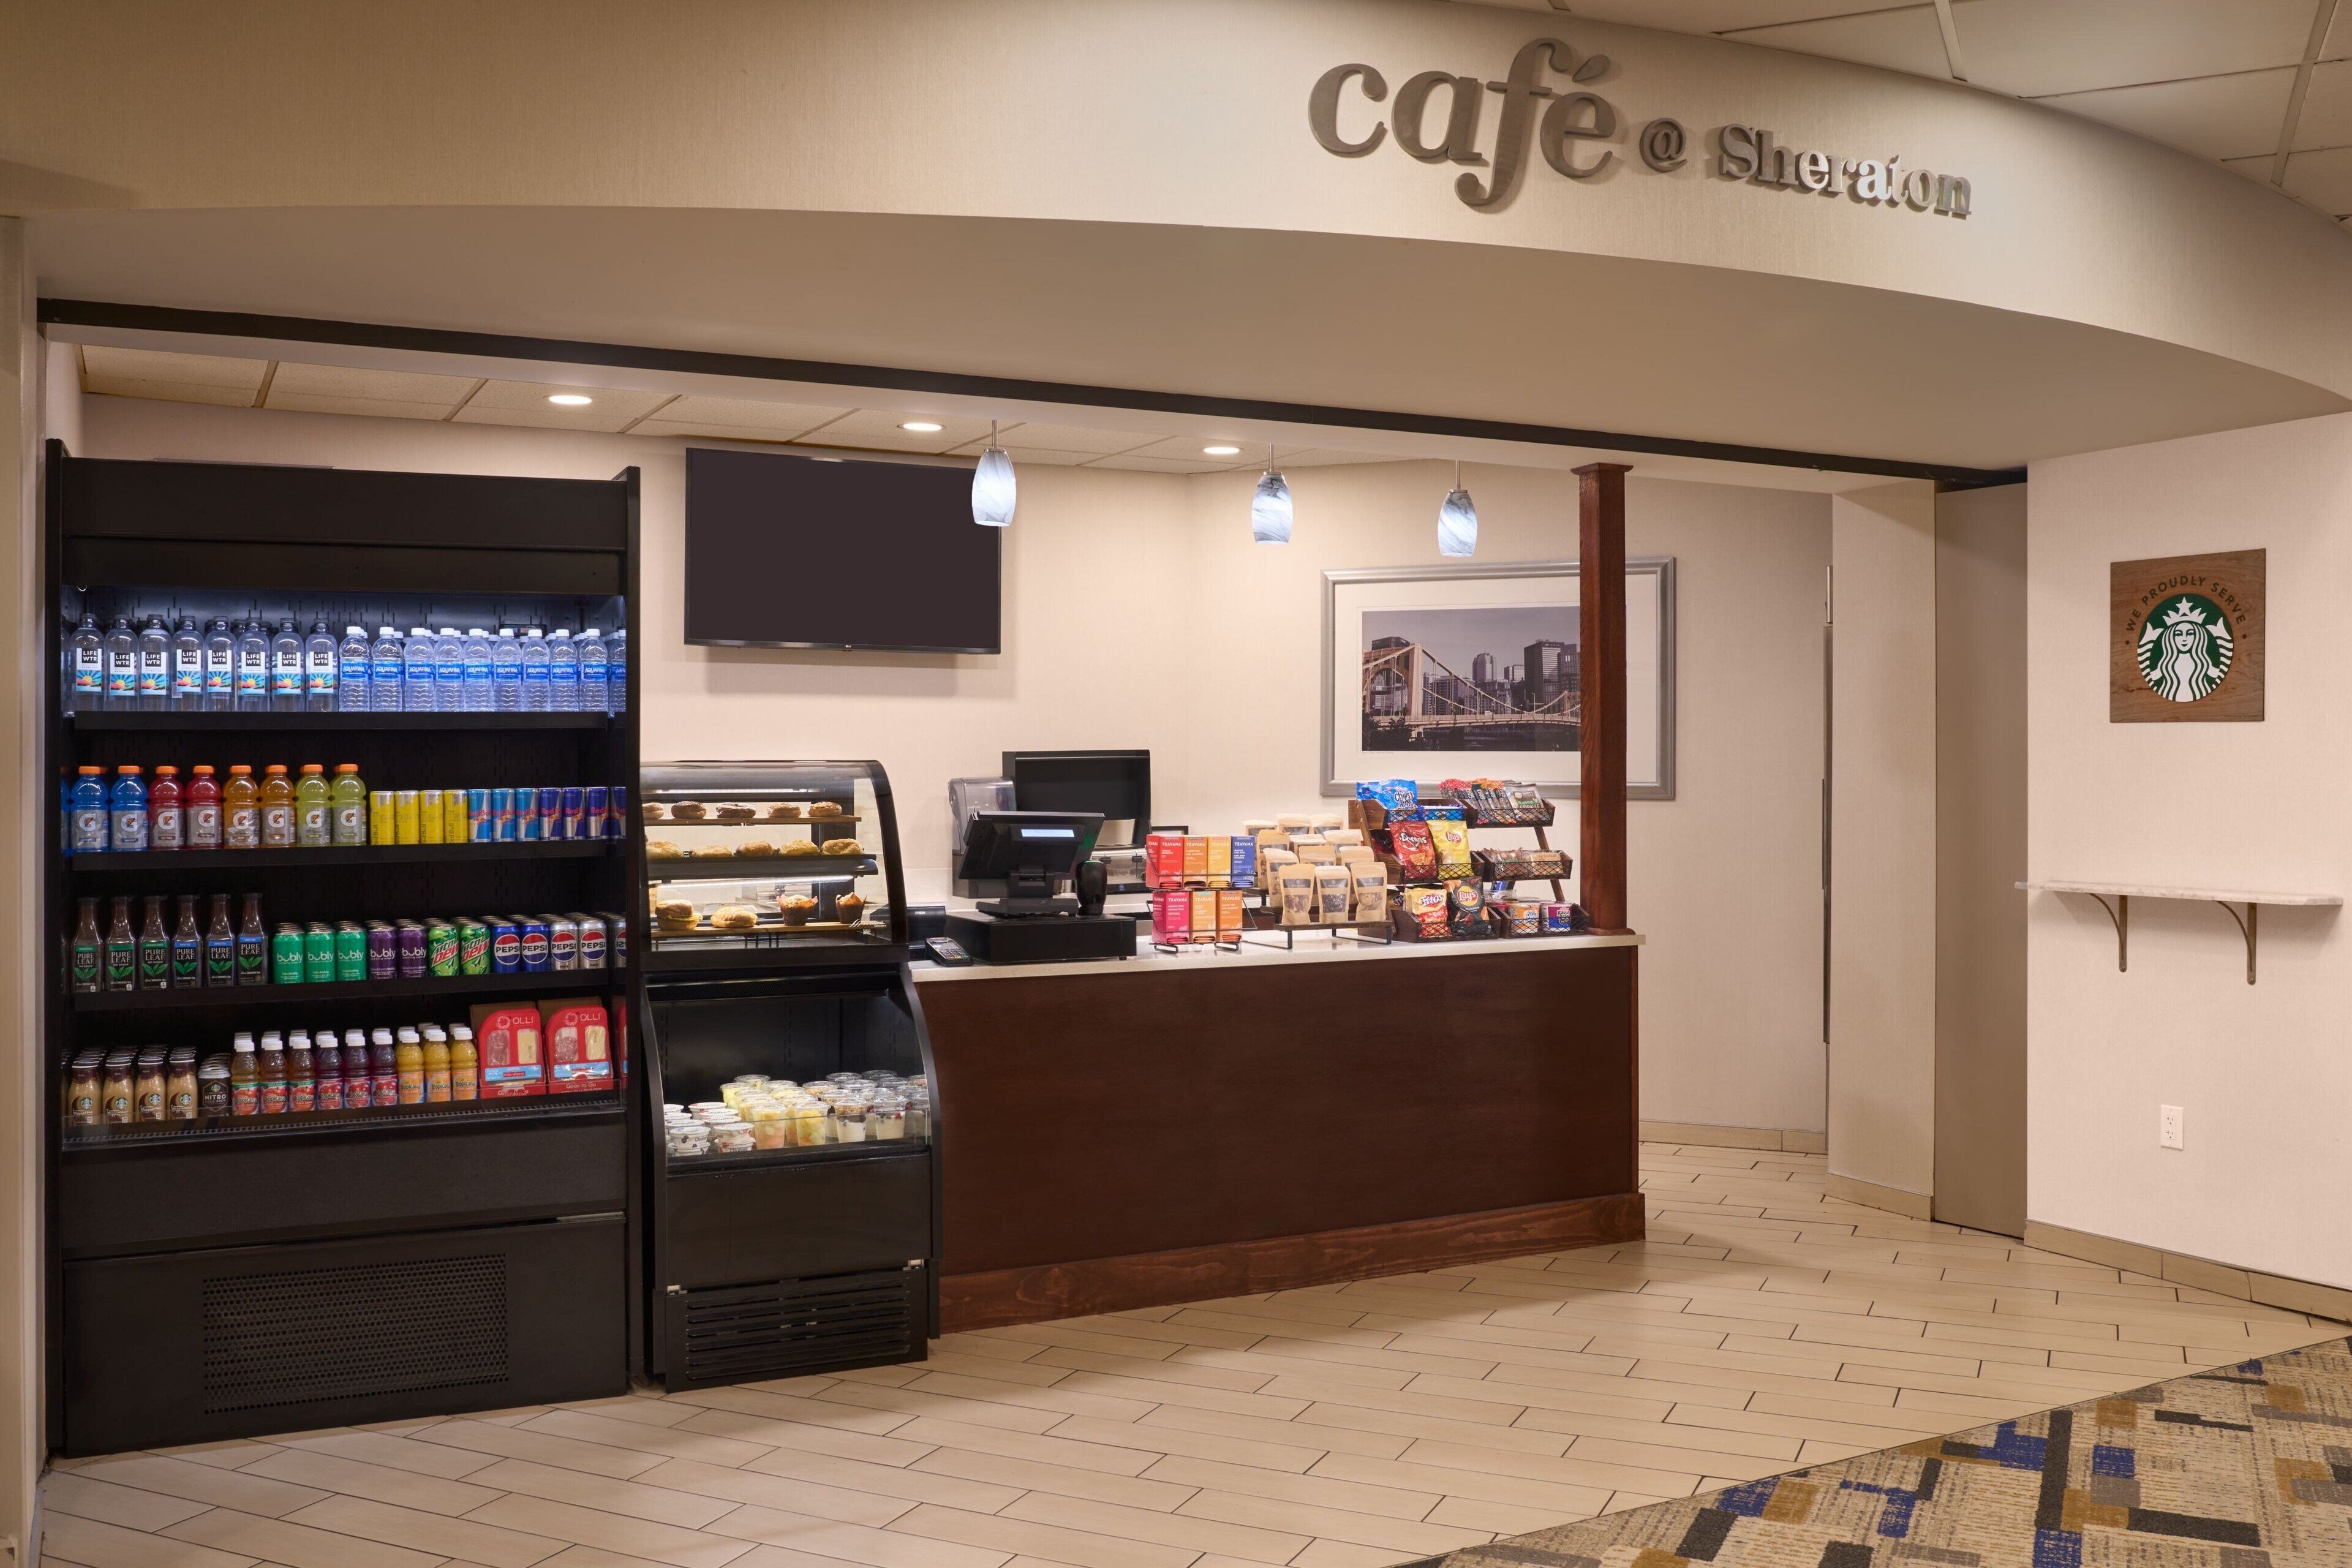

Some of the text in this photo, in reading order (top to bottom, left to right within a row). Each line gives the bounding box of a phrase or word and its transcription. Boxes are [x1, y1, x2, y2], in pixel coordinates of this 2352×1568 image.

[1308, 37, 1972, 219] café @ Sheraton
[2126, 575, 2246, 631] WE PROUDLY SERVE
[1394, 791, 1412, 802] Chips
[79, 813, 97, 832] G
[121, 813, 138, 832] G
[158, 812, 175, 829] G
[198, 810, 216, 827] G
[233, 812, 249, 830] G
[268, 810, 284, 827] G
[306, 810, 322, 828] G
[341, 810, 357, 827] G
[1400, 832, 1427, 844] Doritos
[1419, 894, 1444, 906] Fritos
[277, 952, 303, 962] bubly
[307, 951, 334, 962] bubly
[338, 949, 364, 960] bubly
[370, 947, 396, 959] bubly
[402, 947, 426, 958] bubly
[580, 1013, 600, 1022] OLLI
